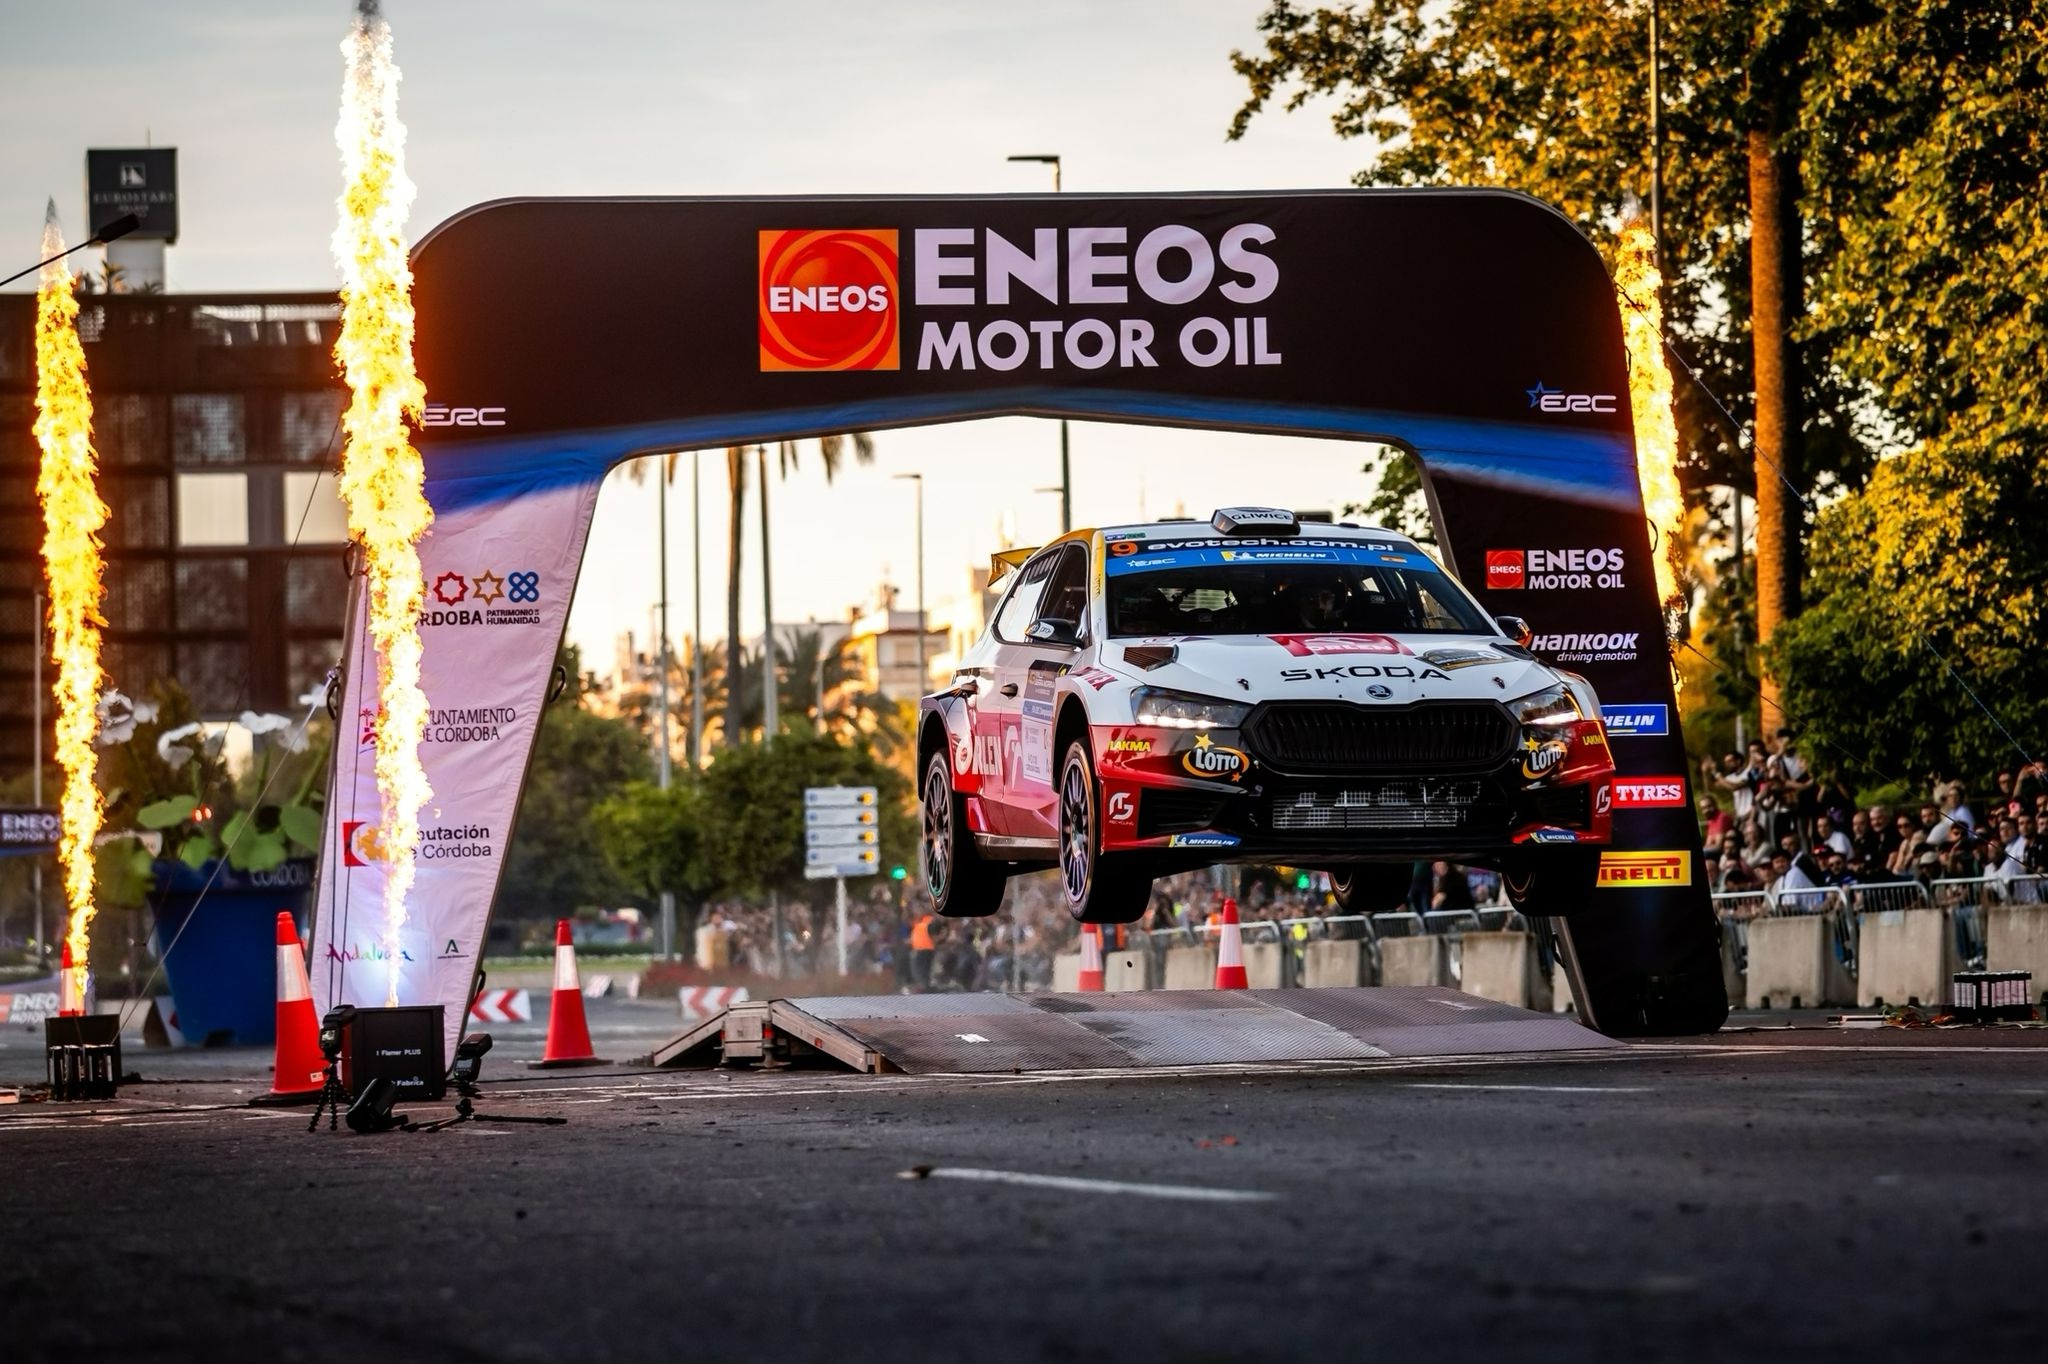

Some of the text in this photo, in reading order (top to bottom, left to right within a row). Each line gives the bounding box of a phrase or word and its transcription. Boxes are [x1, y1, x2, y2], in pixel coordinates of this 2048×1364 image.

[914, 223, 1280, 305] ENEOS
[769, 285, 889, 313] ENEOS
[917, 316, 1282, 371] MOTOR OIL
[1540, 394, 1617, 413] ERC
[1231, 512, 1292, 521] GLIWICE
[1111, 541, 1138, 557] 9
[1147, 537, 1394, 551] evotech.com.pl
[1527, 548, 1625, 572] ENEOS
[1489, 565, 1522, 574] ENEOS
[1529, 573, 1625, 589] MOTOR OIL
[416, 609, 484, 627] RDOBA
[486, 609, 534, 617] PATRIMONIO
[486, 616, 540, 625] HUMANIDAD
[1556, 651, 1638, 664] driving emotion
[1603, 715, 1656, 727] HELIN
[1108, 740, 1151, 752] LAKMA
[1582, 734, 1603, 746] LAKM
[1615, 785, 1682, 801] TYRES
[417, 824, 490, 841] utación
[1188, 838, 1236, 846] MICHELIN
[422, 843, 492, 860] Córdoba
[1600, 867, 1681, 881] IRELLI
[12, 992, 59, 1011] ENEO
[404, 1048, 422, 1056] PLUS
